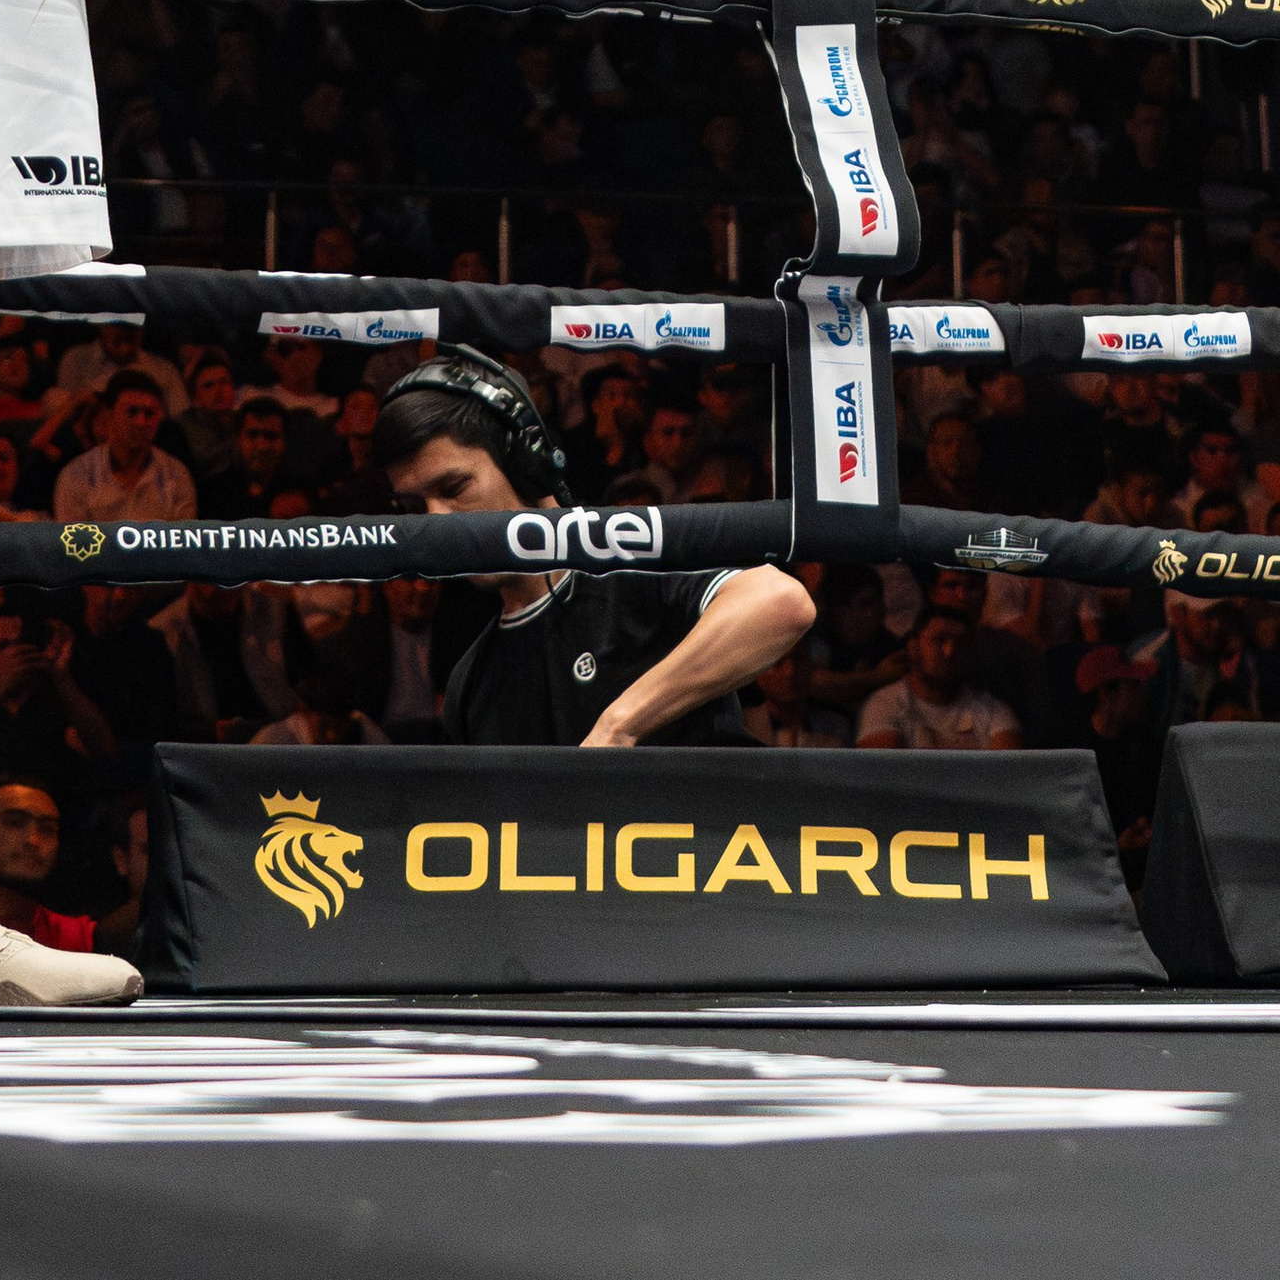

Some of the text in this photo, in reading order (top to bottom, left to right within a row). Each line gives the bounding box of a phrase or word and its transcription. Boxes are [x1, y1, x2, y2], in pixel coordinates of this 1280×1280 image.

[71, 156, 106, 187] IB
[844, 148, 875, 194] IBA
[302, 324, 342, 339] IBA
[594, 323, 634, 339] IBA
[889, 324, 914, 340] BA
[1125, 332, 1163, 350] IBA
[835, 381, 858, 438] IBA
[507, 506, 663, 560] artel
[405, 822, 1049, 900] OLIGARCH
